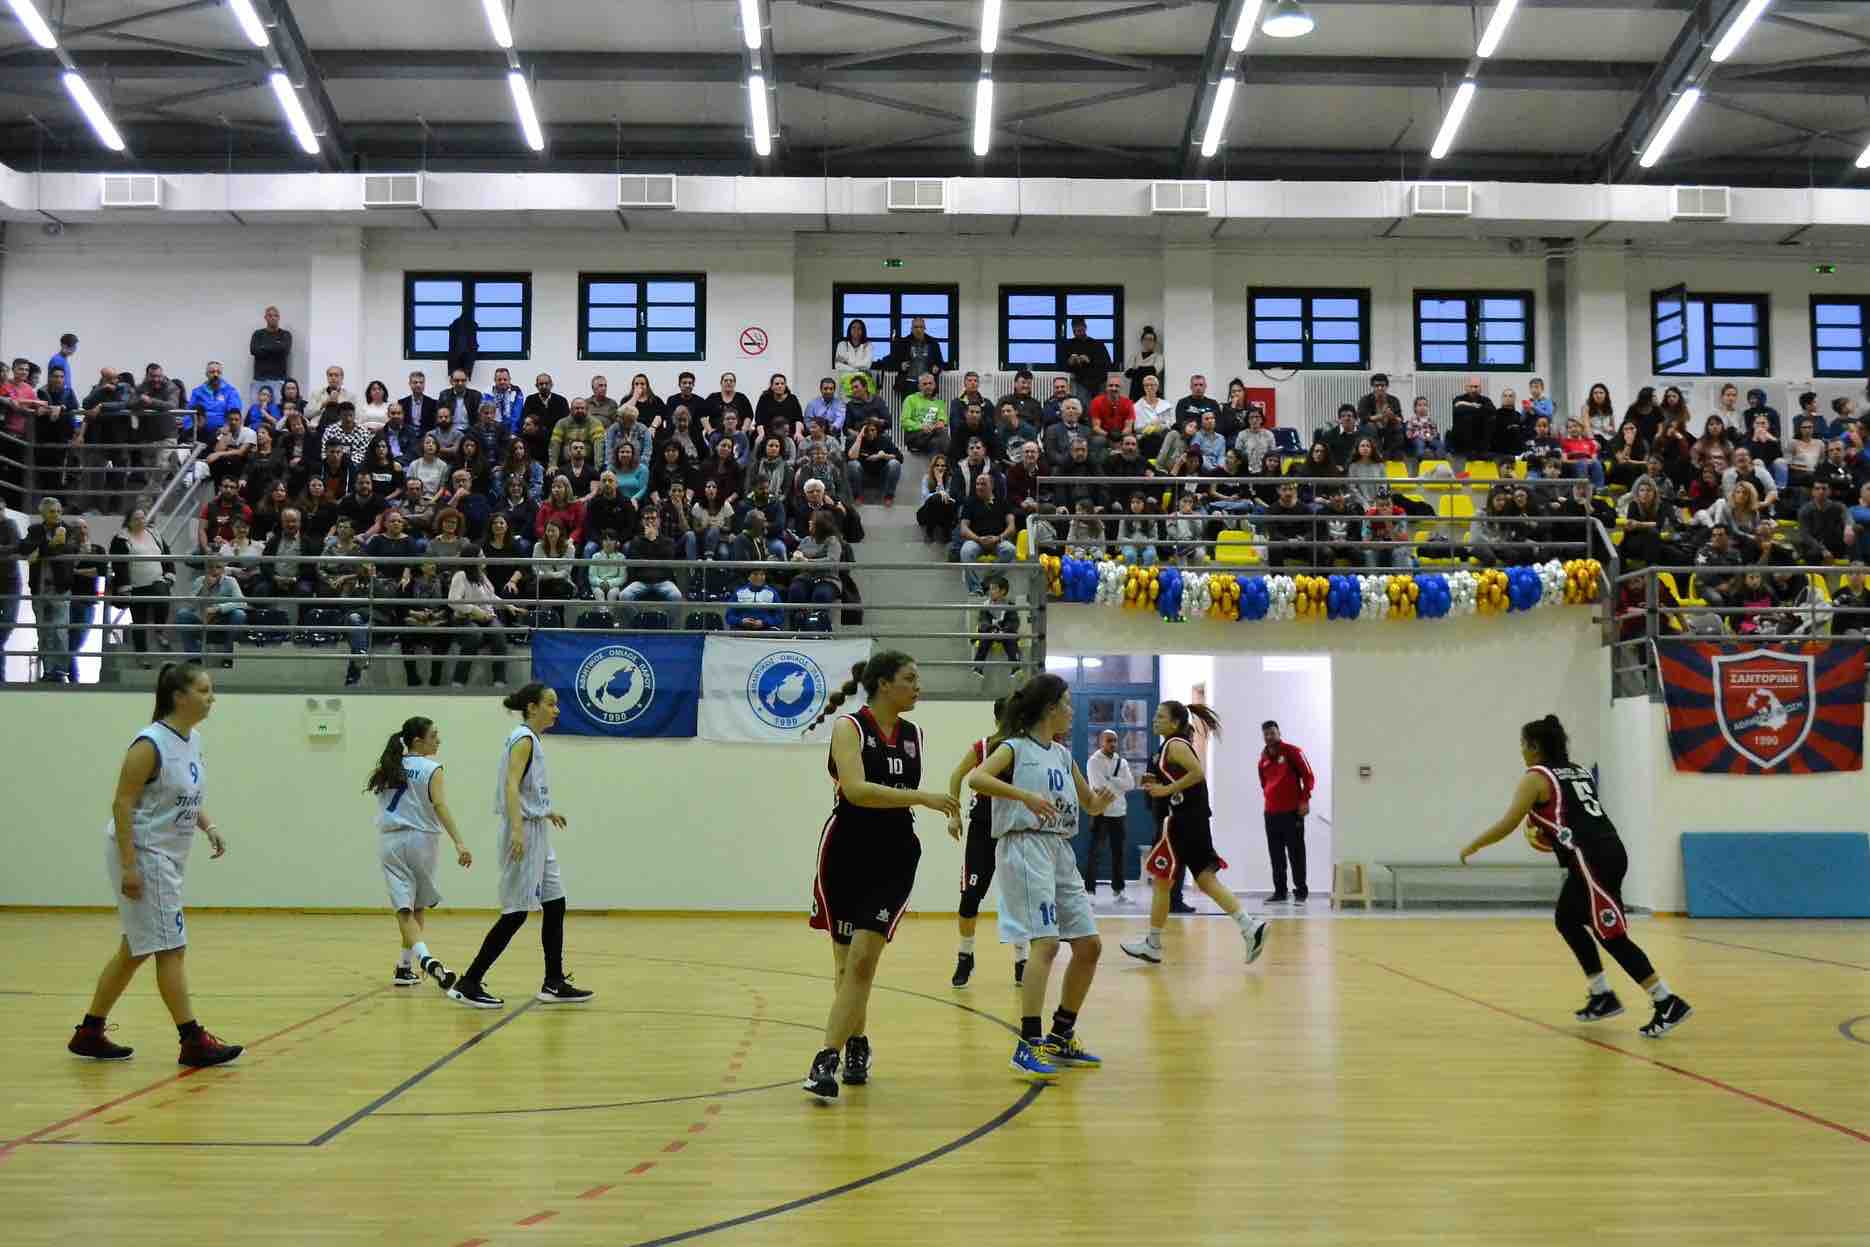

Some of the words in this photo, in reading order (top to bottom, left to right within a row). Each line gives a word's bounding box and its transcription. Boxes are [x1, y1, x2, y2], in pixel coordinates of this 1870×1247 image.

[189, 761, 199, 785] 9
[887, 756, 904, 775] 10
[1047, 767, 1064, 793] 10
[1571, 781, 1603, 817] 5
[969, 874, 979, 886] 8
[175, 911, 184, 935] 9
[837, 919, 854, 937] 10
